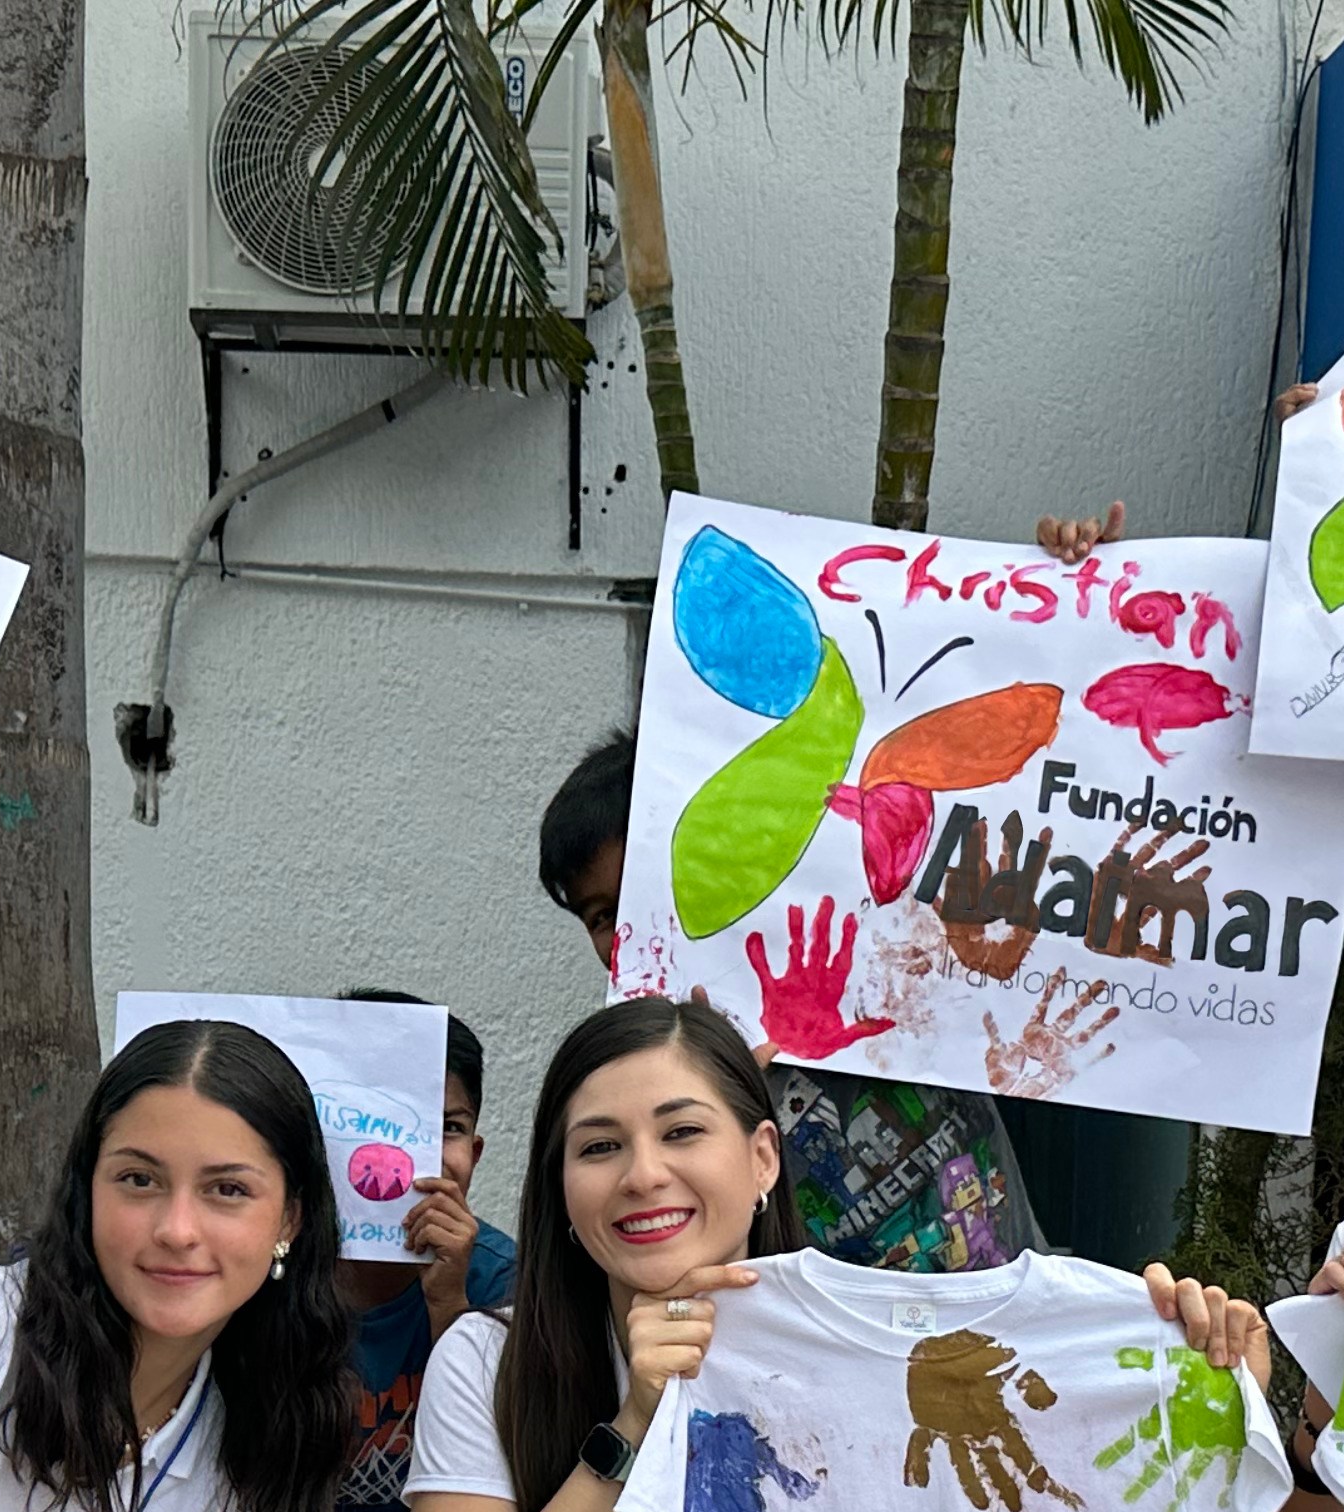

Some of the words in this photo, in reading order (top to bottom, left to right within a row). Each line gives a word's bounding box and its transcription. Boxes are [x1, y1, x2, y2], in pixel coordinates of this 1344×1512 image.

[818, 538, 1242, 662] Christian
[1038, 760, 1256, 844] Fundación
[914, 803, 1339, 977] Adaimar
[1188, 974, 1276, 1027] vidas
